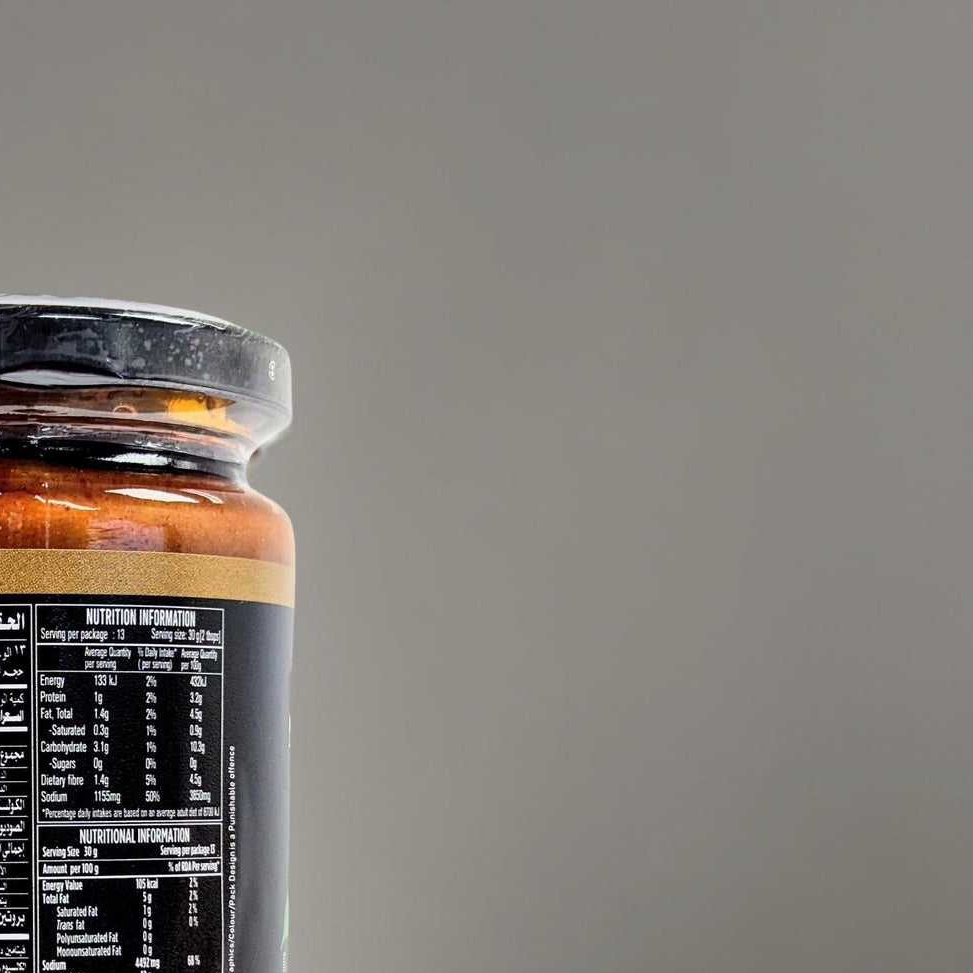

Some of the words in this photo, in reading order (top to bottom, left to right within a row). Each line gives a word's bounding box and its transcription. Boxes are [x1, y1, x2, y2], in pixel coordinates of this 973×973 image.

[86, 608, 137, 626] NUTRITION
[139, 609, 196, 627] INFORMATION
[41, 628, 66, 641] Serving
[67, 630, 79, 642] per
[81, 629, 109, 642] package
[117, 629, 125, 640] 13
[85, 646, 107, 658] Average
[109, 647, 131, 660] Quantity
[85, 660, 95, 671] per
[96, 660, 117, 671] serving
[40, 674, 65, 688] Energy
[94, 674, 107, 686] 133
[109, 674, 117, 686] kJ
[145, 676, 157, 687] 2%
[40, 691, 66, 703] Protein
[94, 692, 103, 704] 1g
[145, 692, 157, 704] 2%
[189, 692, 203, 706] 3.2g
[41, 708, 54, 720] Fat,
[55, 708, 73, 719] Total
[94, 708, 109, 722] 1.4g
[145, 708, 157, 720] 2%
[189, 708, 203, 722] 4.5g
[49, 724, 86, 736] -Saturated
[93, 724, 109, 738] 0.3g
[41, 741, 87, 755] Carbohydrate
[93, 742, 109, 754] 3.1g
[49, 758, 76, 770] -Sugars
[93, 758, 103, 770] 0g
[228, 746, 236, 779] offence
[41, 774, 66, 788] Dietary
[67, 774, 84, 786] fibre
[94, 774, 109, 788] 1.4g
[41, 790, 67, 802] Sodium
[94, 791, 121, 804] 1155mg
[145, 791, 161, 802] 50%
[228, 782, 236, 831] Punishable
[79, 828, 136, 844] NUTRITIONAL
[137, 828, 191, 844] INFORMATION
[42, 846, 67, 859] Serving
[67, 846, 80, 857] Size
[84, 846, 92, 857] 30
[228, 842, 236, 850] is
[42, 863, 68, 874] Amount
[70, 865, 81, 876] per
[82, 862, 93, 874] 100
[228, 850, 236, 882] Design
[42, 960, 67, 971] Sodium
